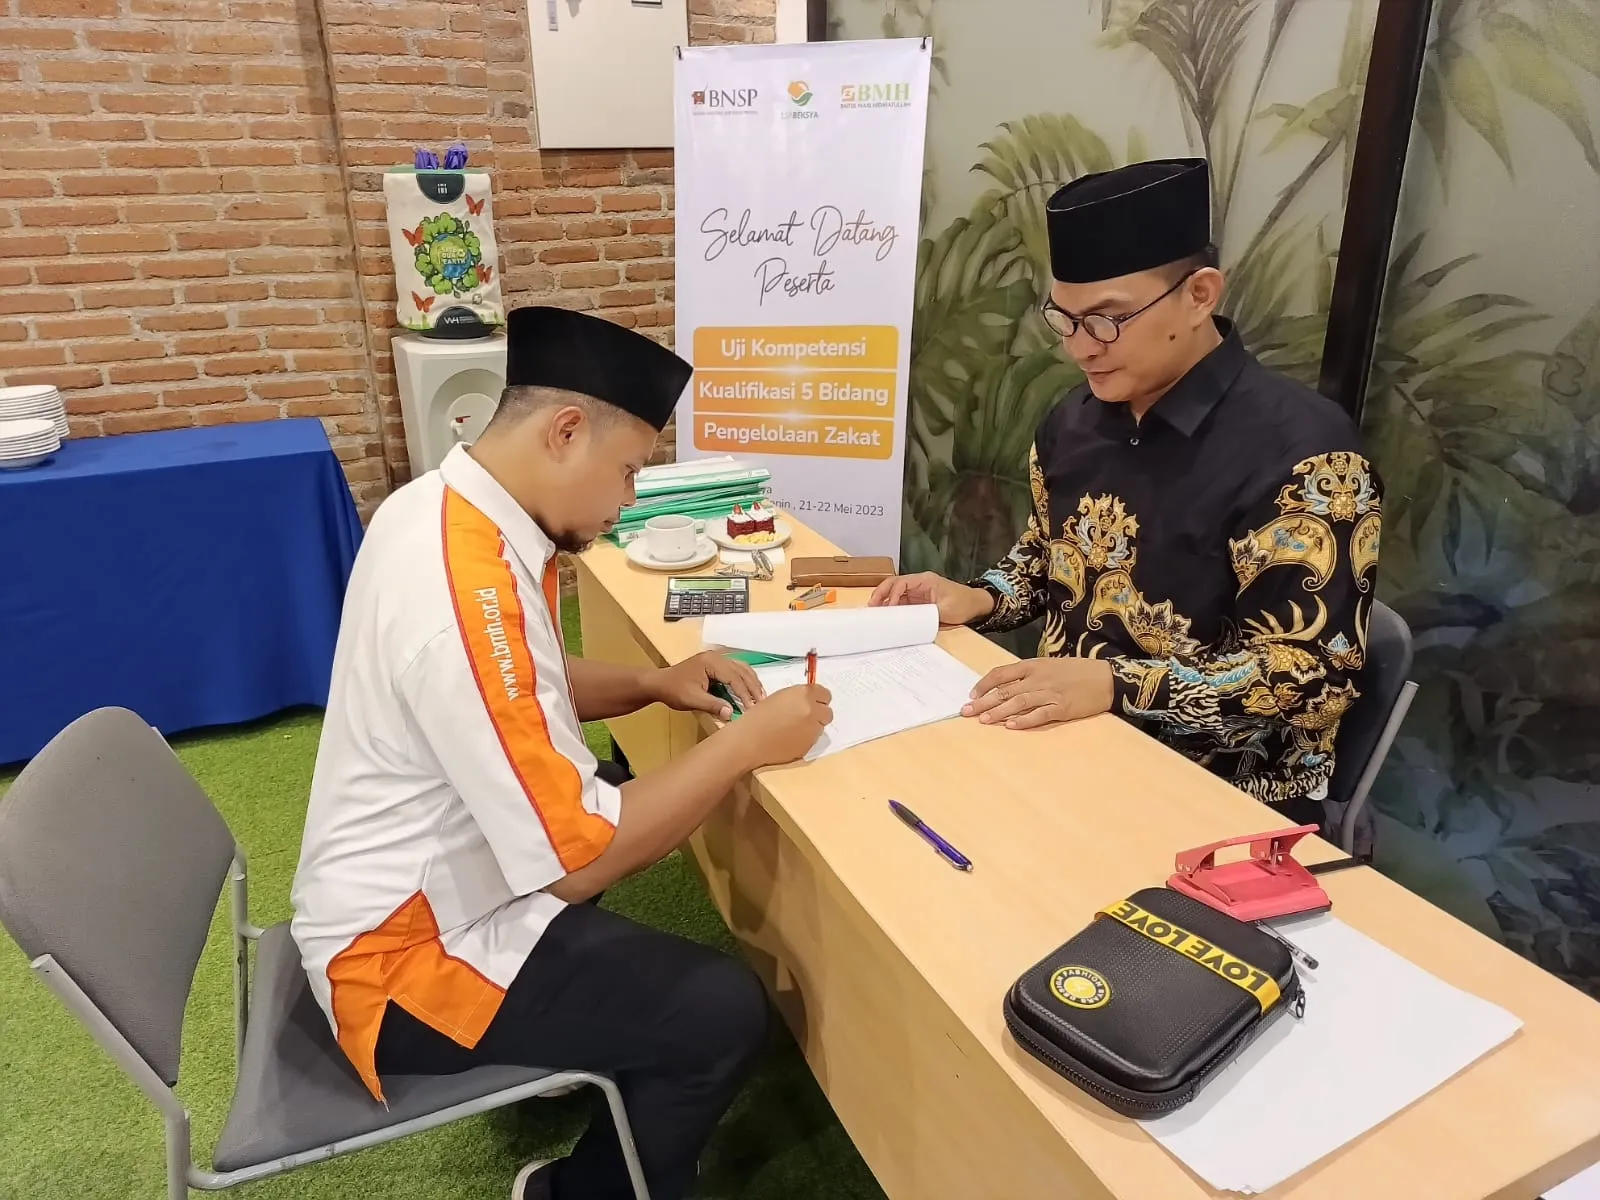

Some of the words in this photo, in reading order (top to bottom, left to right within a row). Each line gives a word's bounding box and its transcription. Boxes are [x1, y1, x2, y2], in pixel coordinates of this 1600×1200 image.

[709, 88, 758, 107] BNSP
[858, 83, 909, 101] BMH
[700, 207, 804, 261] Selamat
[810, 205, 899, 261] Datang
[754, 257, 835, 306] Peserta
[721, 338, 746, 360] Uji
[751, 337, 866, 360] Kompetensi
[699, 381, 796, 401] Kualifikasi
[801, 383, 813, 400] 5
[819, 382, 889, 406] Bidang
[704, 423, 819, 444] Pengelolaan
[824, 426, 881, 446] Zakat
[799, 499, 831, 512] 21-22
[833, 503, 853, 515] Mei
[855, 504, 884, 517] 2023
[472, 587, 520, 701] www.bmh.or.id
[1111, 902, 1190, 948] LOVE
[1184, 939, 1269, 993] LOVE
